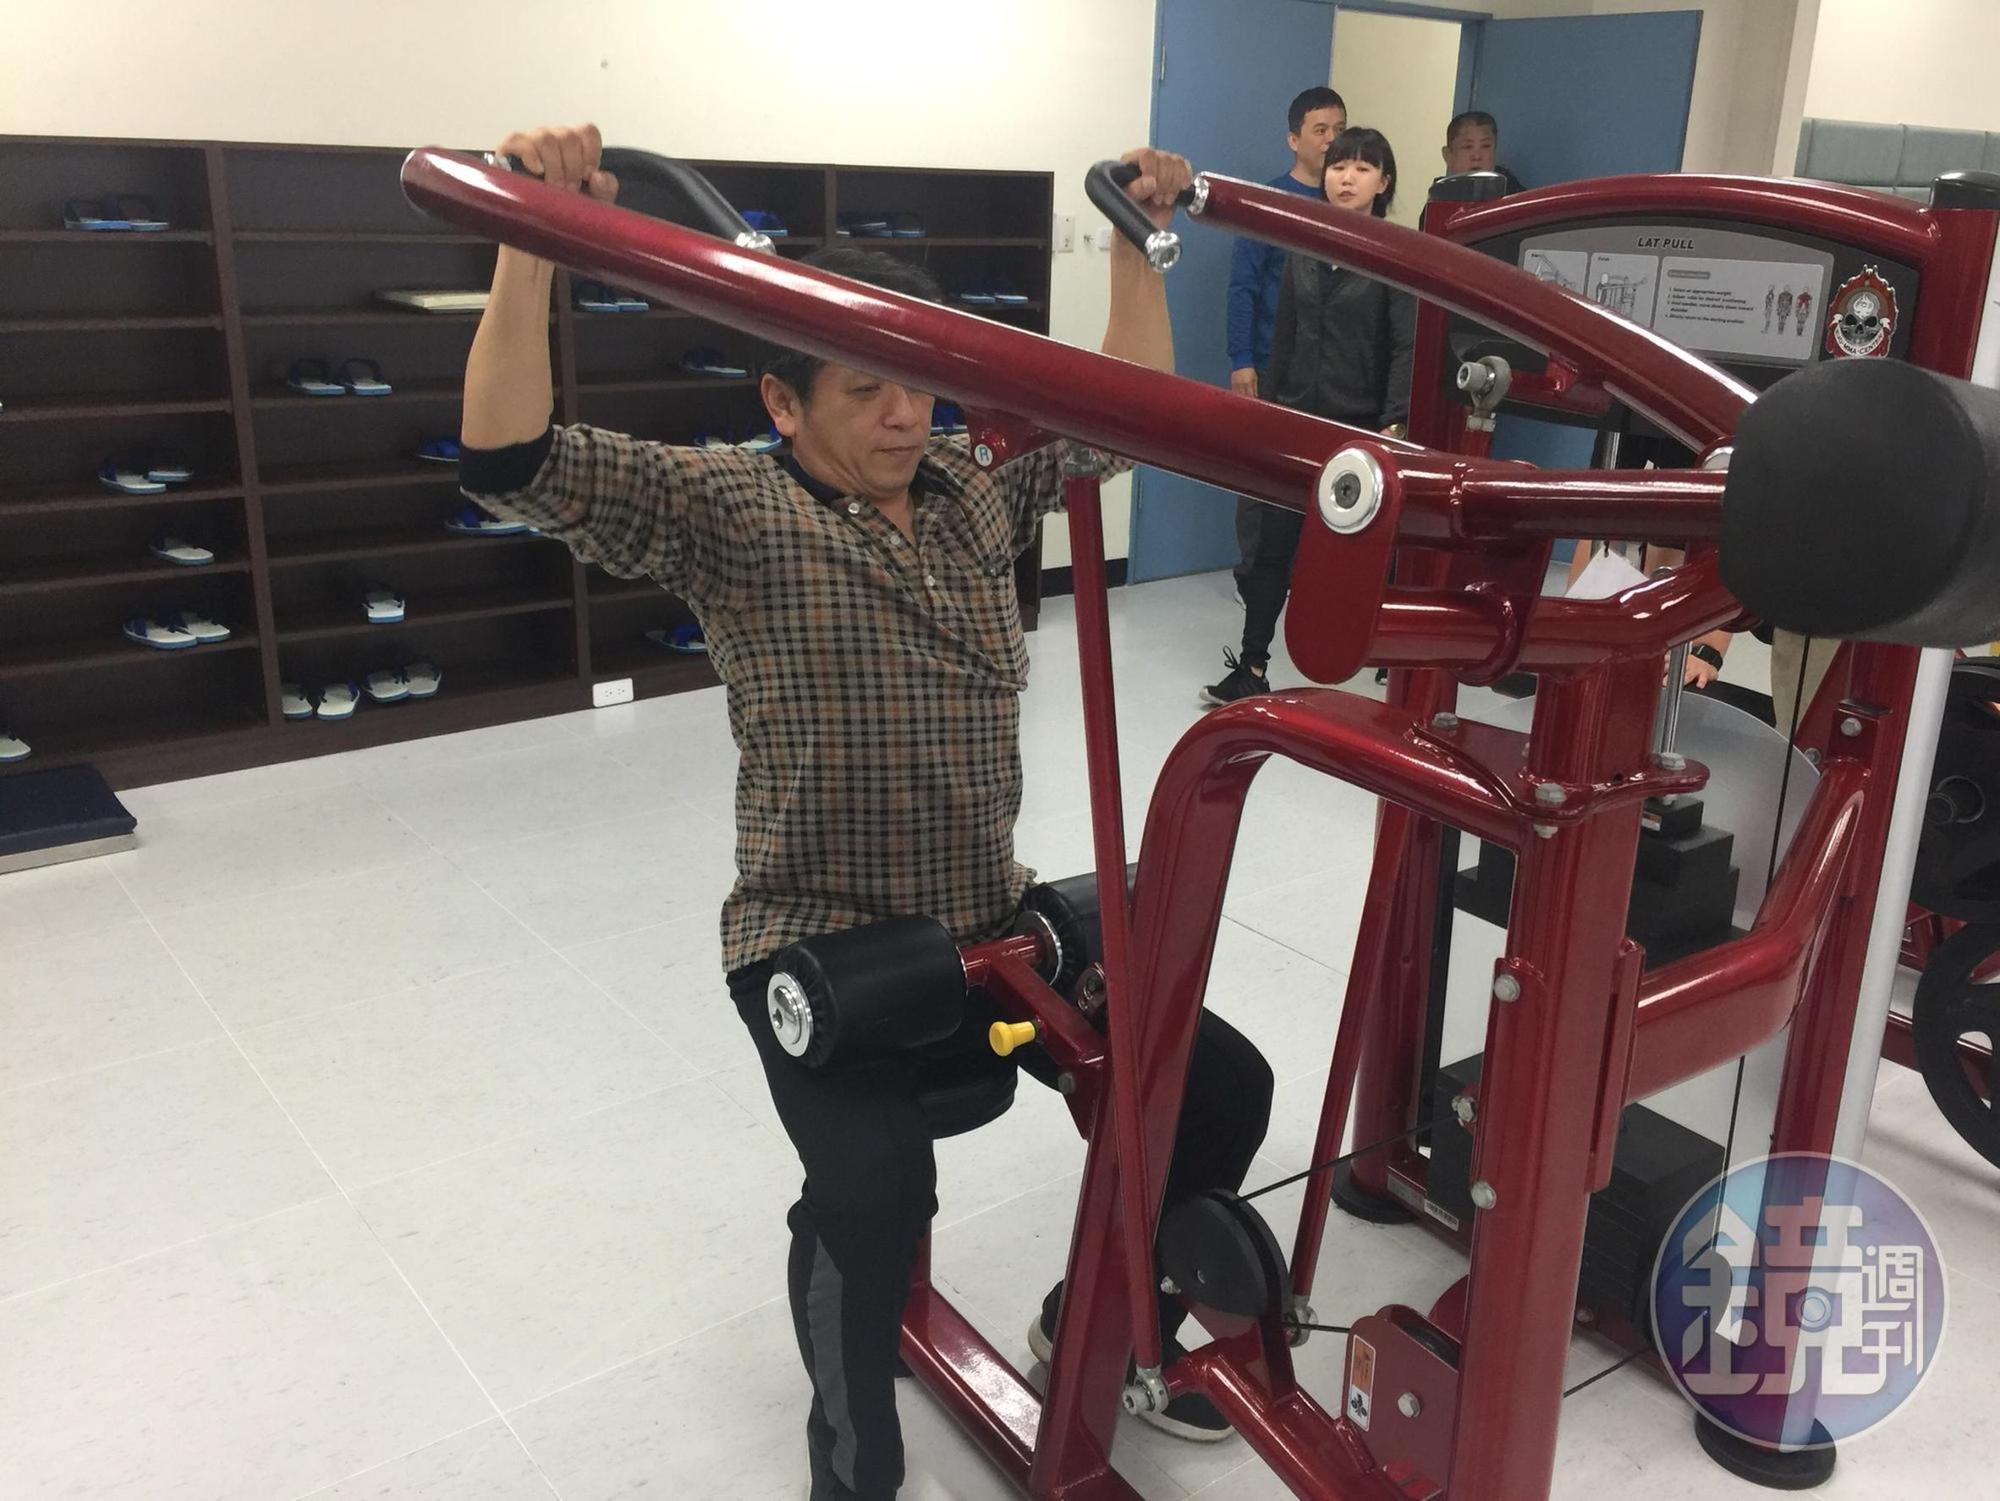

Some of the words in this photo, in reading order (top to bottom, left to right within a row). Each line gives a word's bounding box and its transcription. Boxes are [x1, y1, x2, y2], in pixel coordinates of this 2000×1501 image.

[1637, 237, 1660, 248] LAT
[1663, 238, 1695, 250] PULL
[979, 447, 990, 462] R
